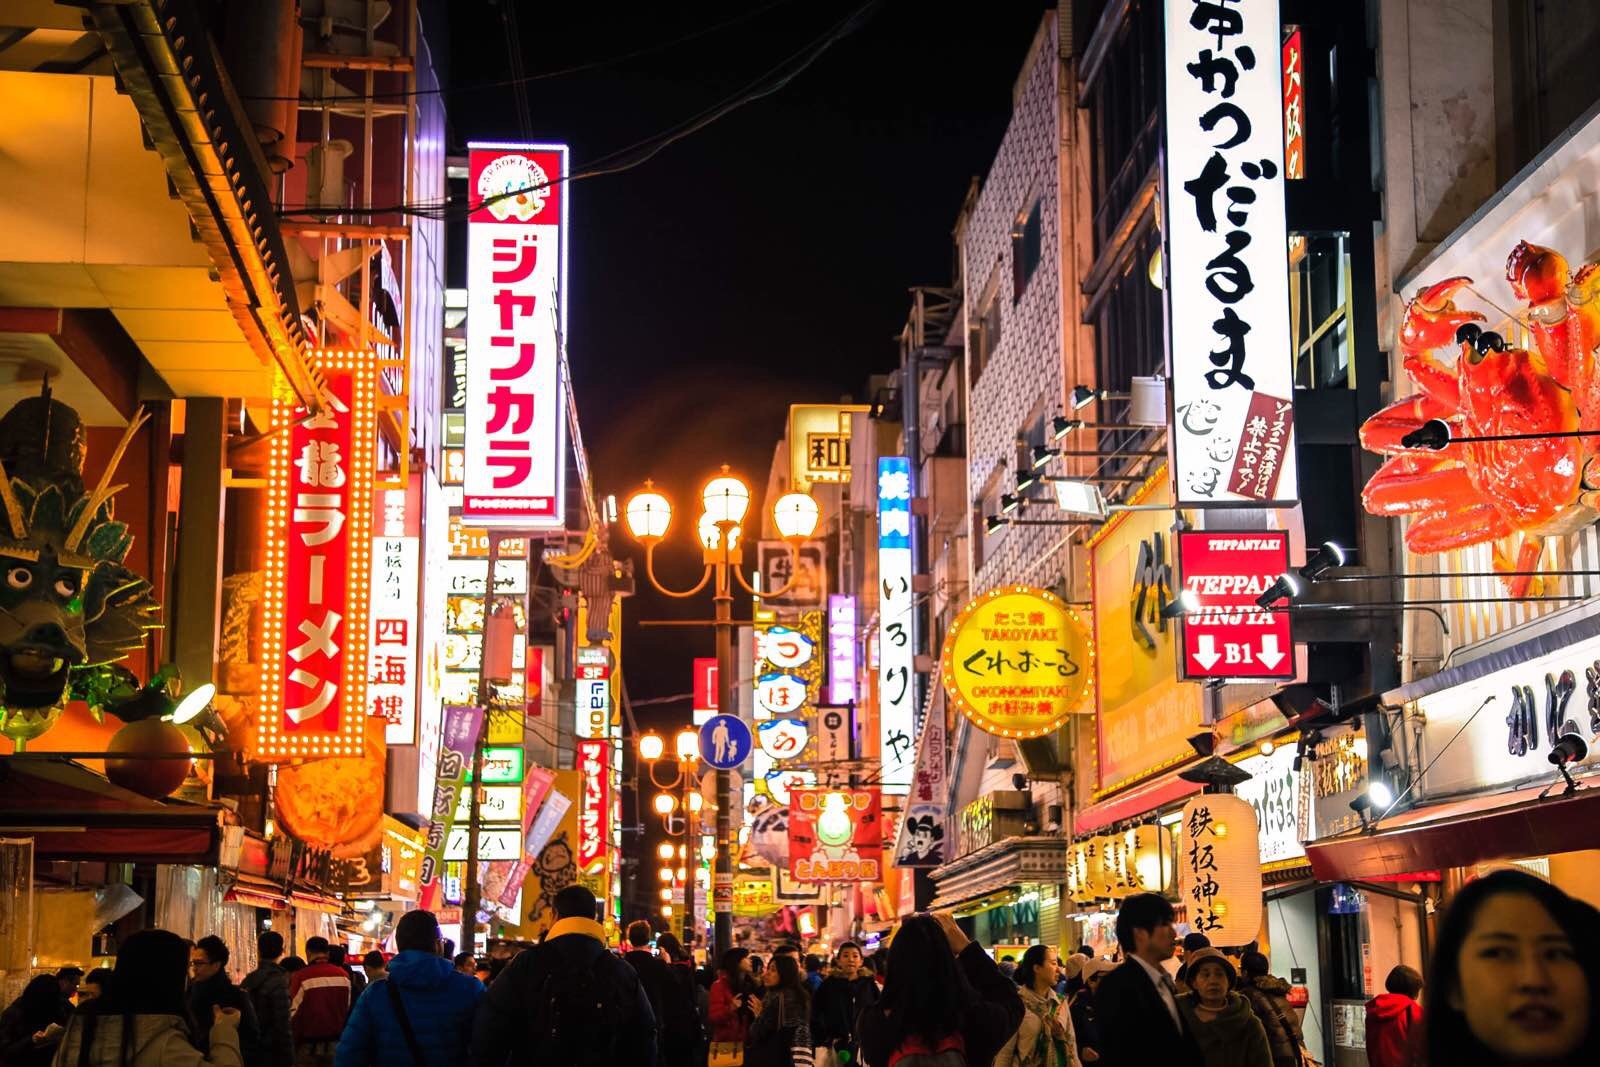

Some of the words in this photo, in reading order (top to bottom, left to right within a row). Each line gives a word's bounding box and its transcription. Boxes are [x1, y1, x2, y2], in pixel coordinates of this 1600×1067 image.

[486, 234, 537, 489] ジャンカラ
[812, 438, 851, 466] 和
[1208, 539, 1281, 551] TEPPANYAKI
[1187, 575, 1280, 595] TEPPAN
[1187, 604, 1276, 626] JINJYA
[981, 628, 1058, 642] TAKOYAKI
[963, 648, 1080, 677] くれおーる
[1224, 643, 1253, 664] B1
[881, 575, 912, 764] いろりや
[971, 685, 1072, 699] OKONOMIYAKI
[1187, 807, 1224, 934] 鉄板神社
